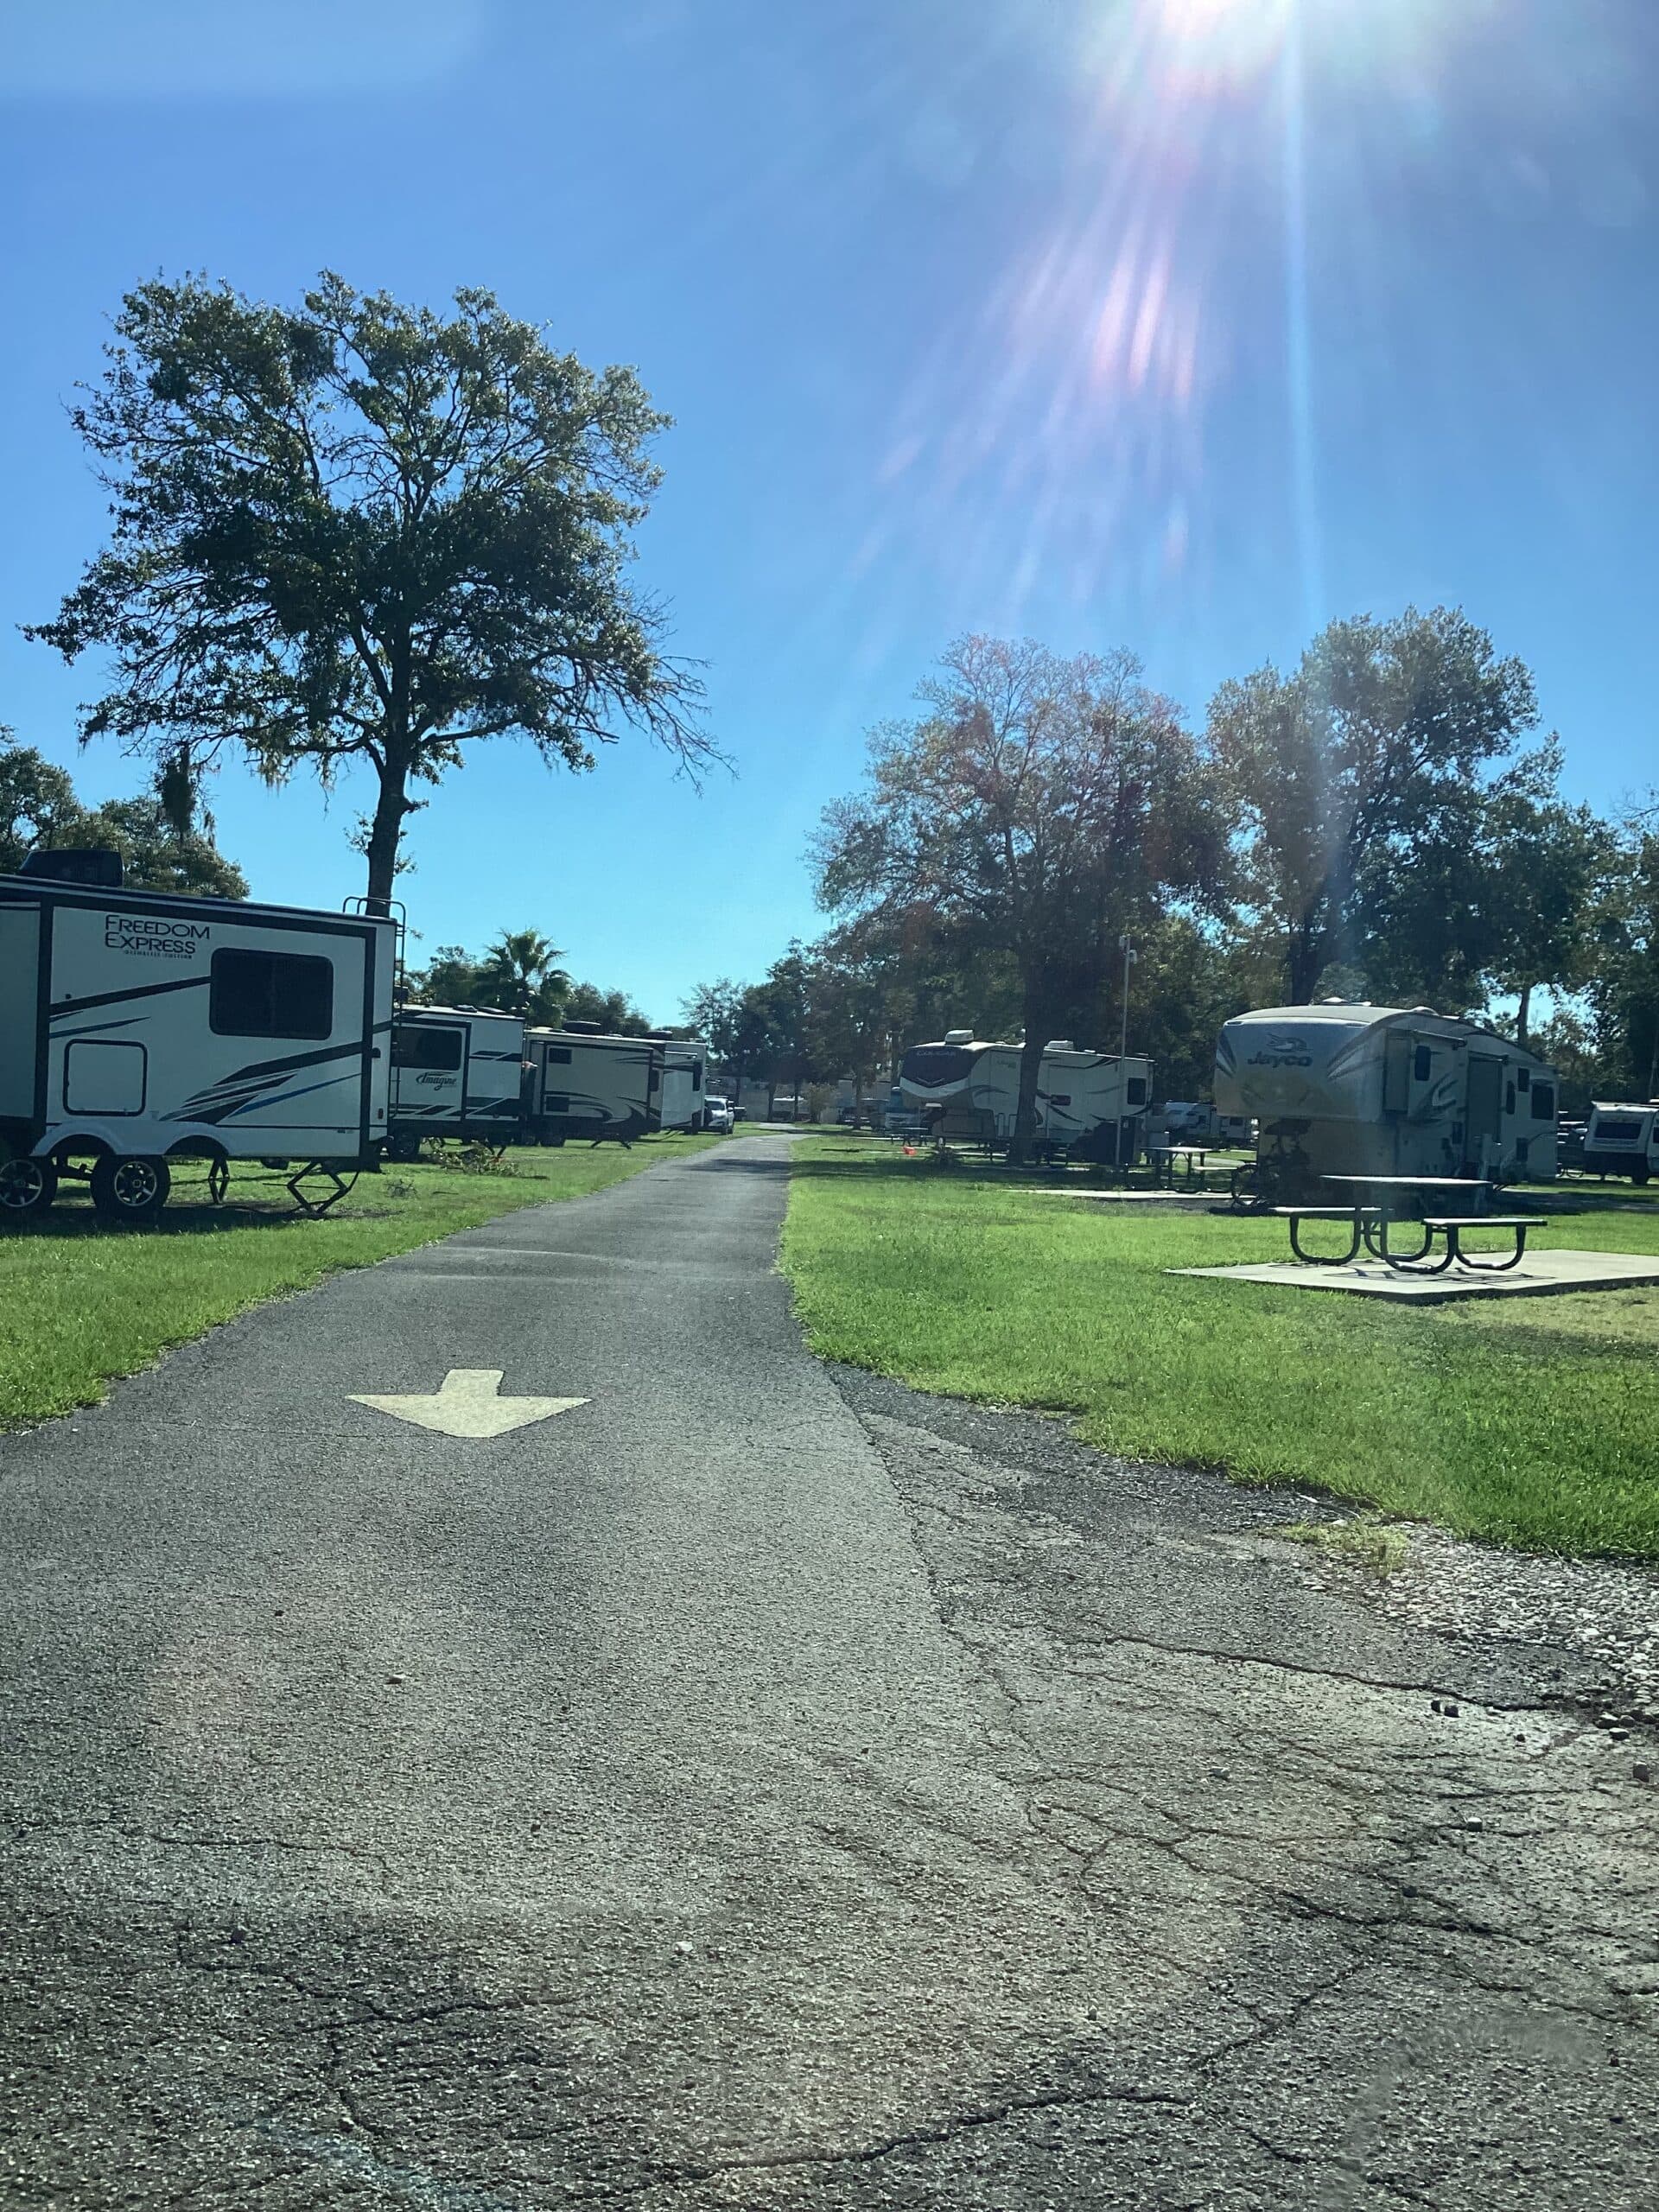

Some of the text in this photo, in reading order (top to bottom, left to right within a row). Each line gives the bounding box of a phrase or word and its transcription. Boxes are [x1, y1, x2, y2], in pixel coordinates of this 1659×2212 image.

[105, 914, 210, 939] FREEDOM
[105, 931, 196, 954] EXPRESS
[1247, 1050, 1313, 1069] Jayco
[416, 1071, 457, 1091] Imagine
